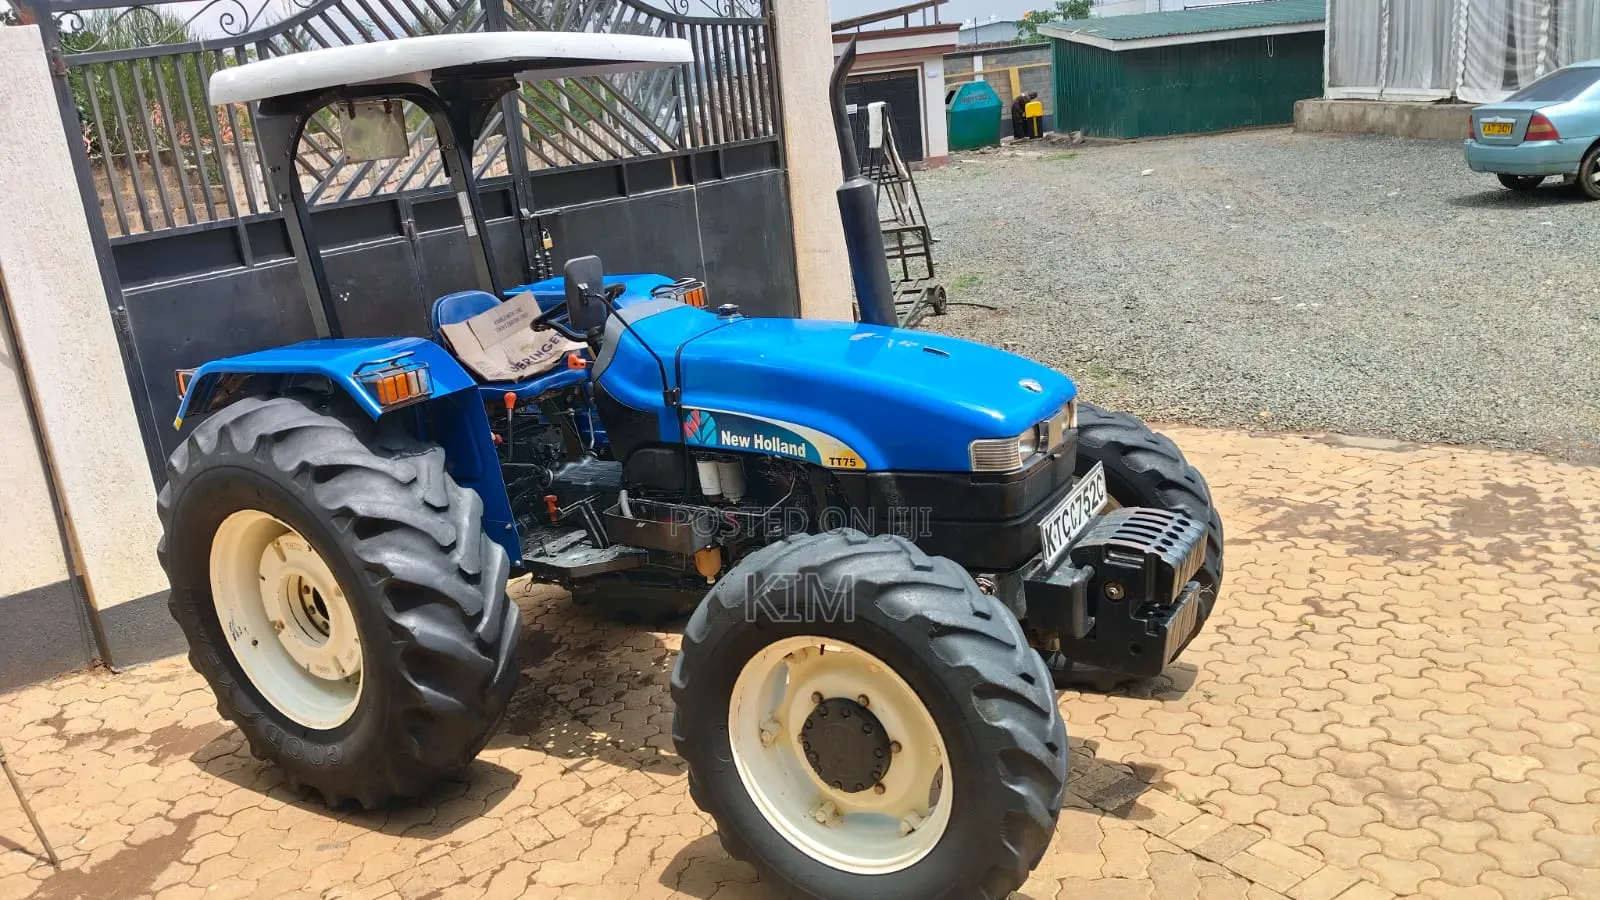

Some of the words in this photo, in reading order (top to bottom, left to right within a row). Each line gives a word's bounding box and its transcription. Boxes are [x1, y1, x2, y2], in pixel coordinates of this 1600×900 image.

[721, 430, 750, 446] New
[754, 433, 806, 458] Holland
[829, 457, 856, 467] TT75
